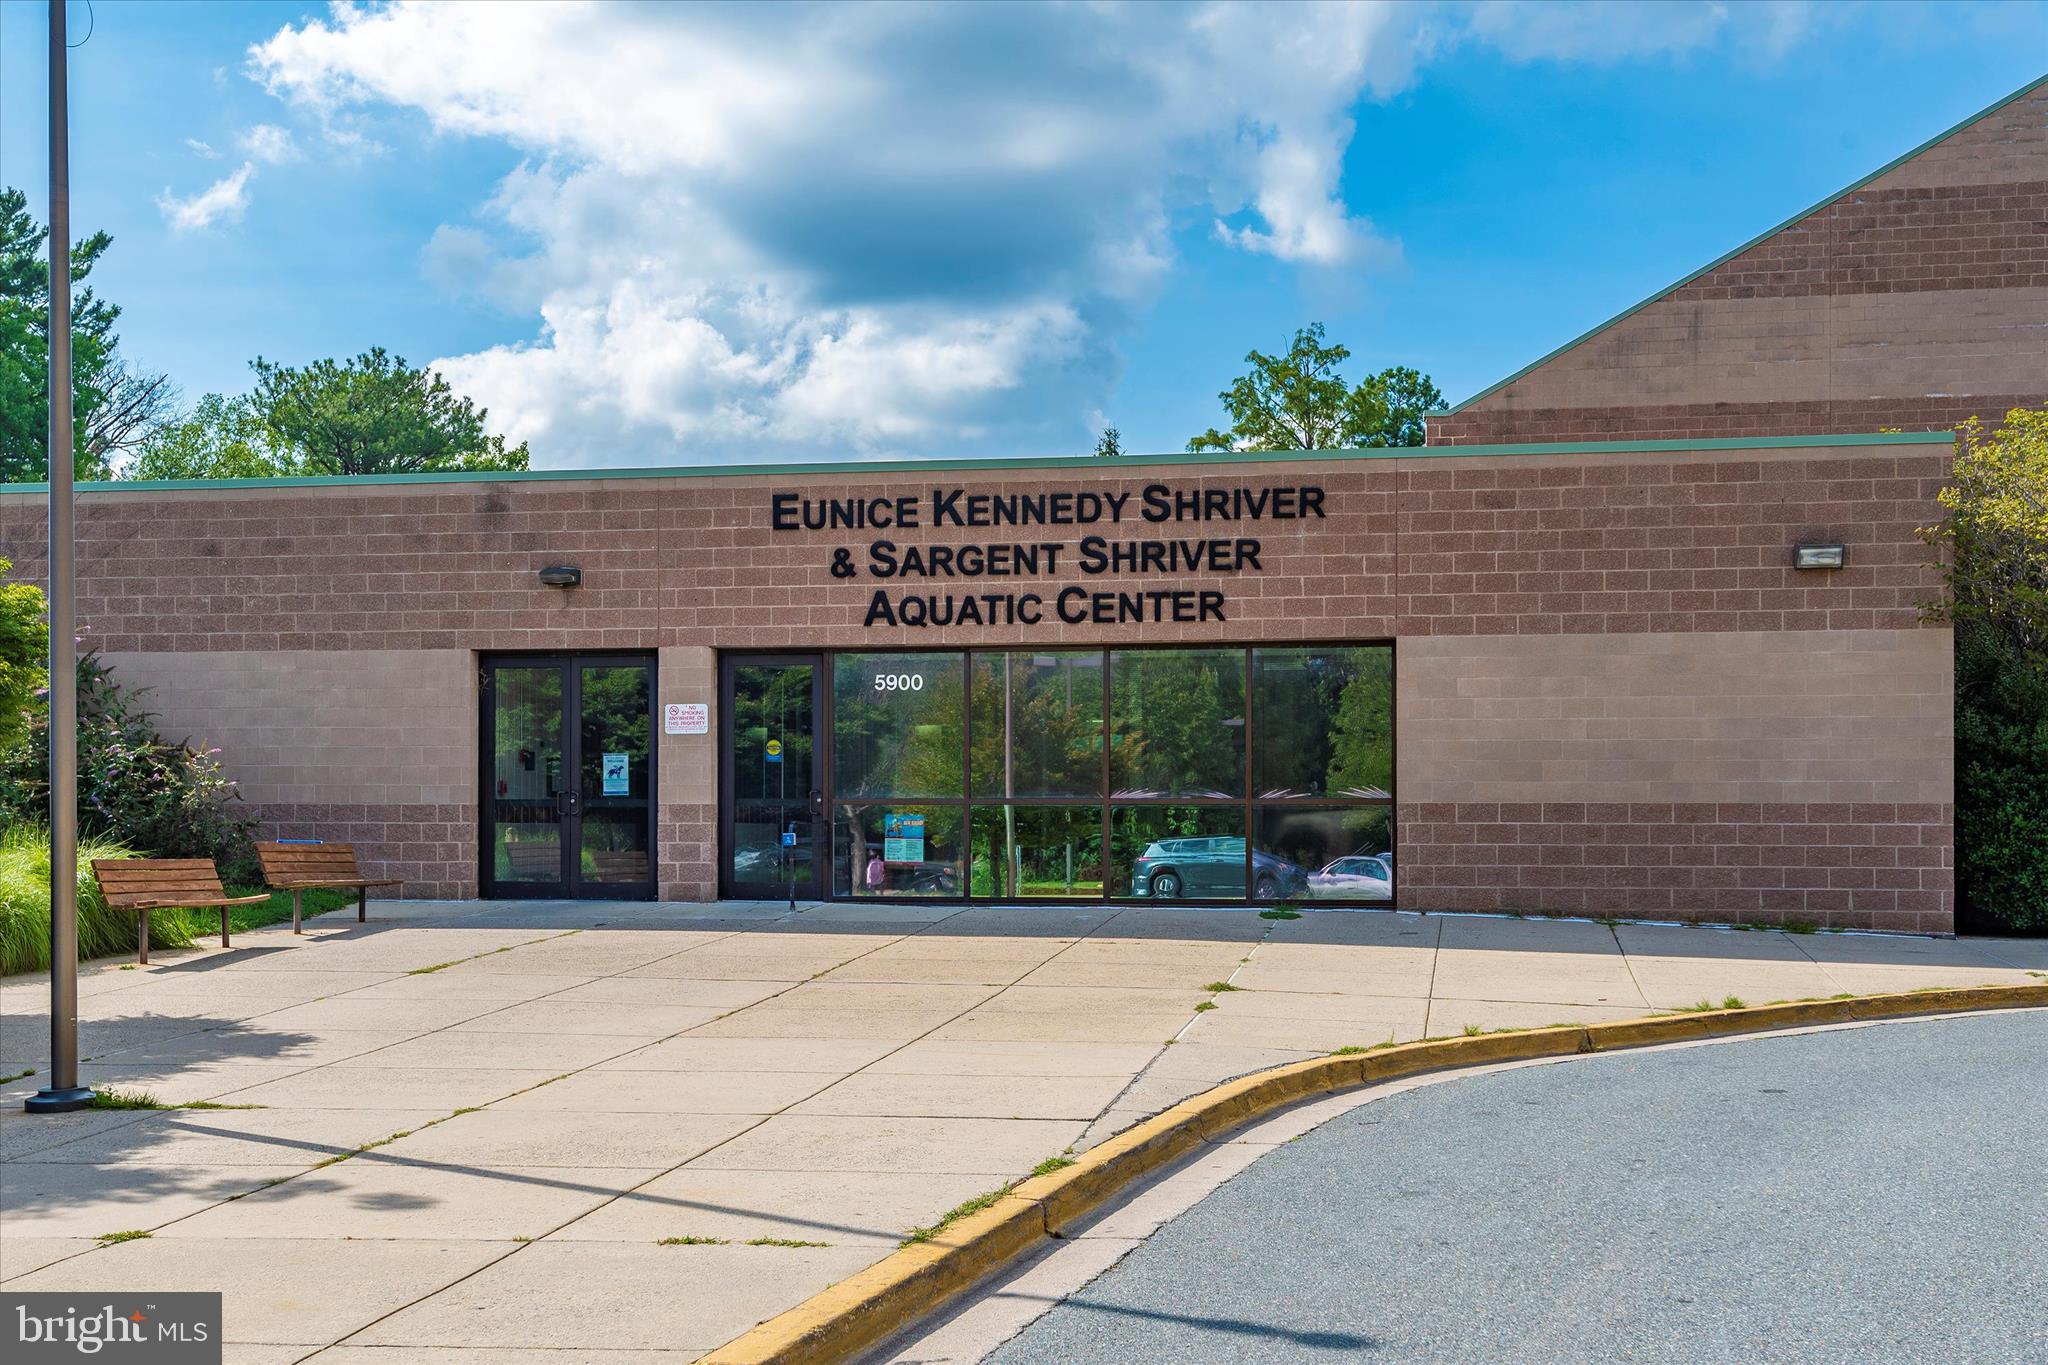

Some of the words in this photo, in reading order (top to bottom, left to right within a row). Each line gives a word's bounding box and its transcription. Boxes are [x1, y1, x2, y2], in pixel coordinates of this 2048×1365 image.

[772, 493, 919, 530] EUNICE
[933, 489, 1130, 527] KENNEDY
[1141, 484, 1326, 522] SHRIVER
[830, 548, 857, 578] &
[869, 540, 1064, 577] SARGENT
[1079, 536, 1262, 574] SHRIVER
[863, 590, 1043, 628] AQUATIC
[1057, 586, 1226, 624] CENTER
[874, 674, 923, 691] 5900
